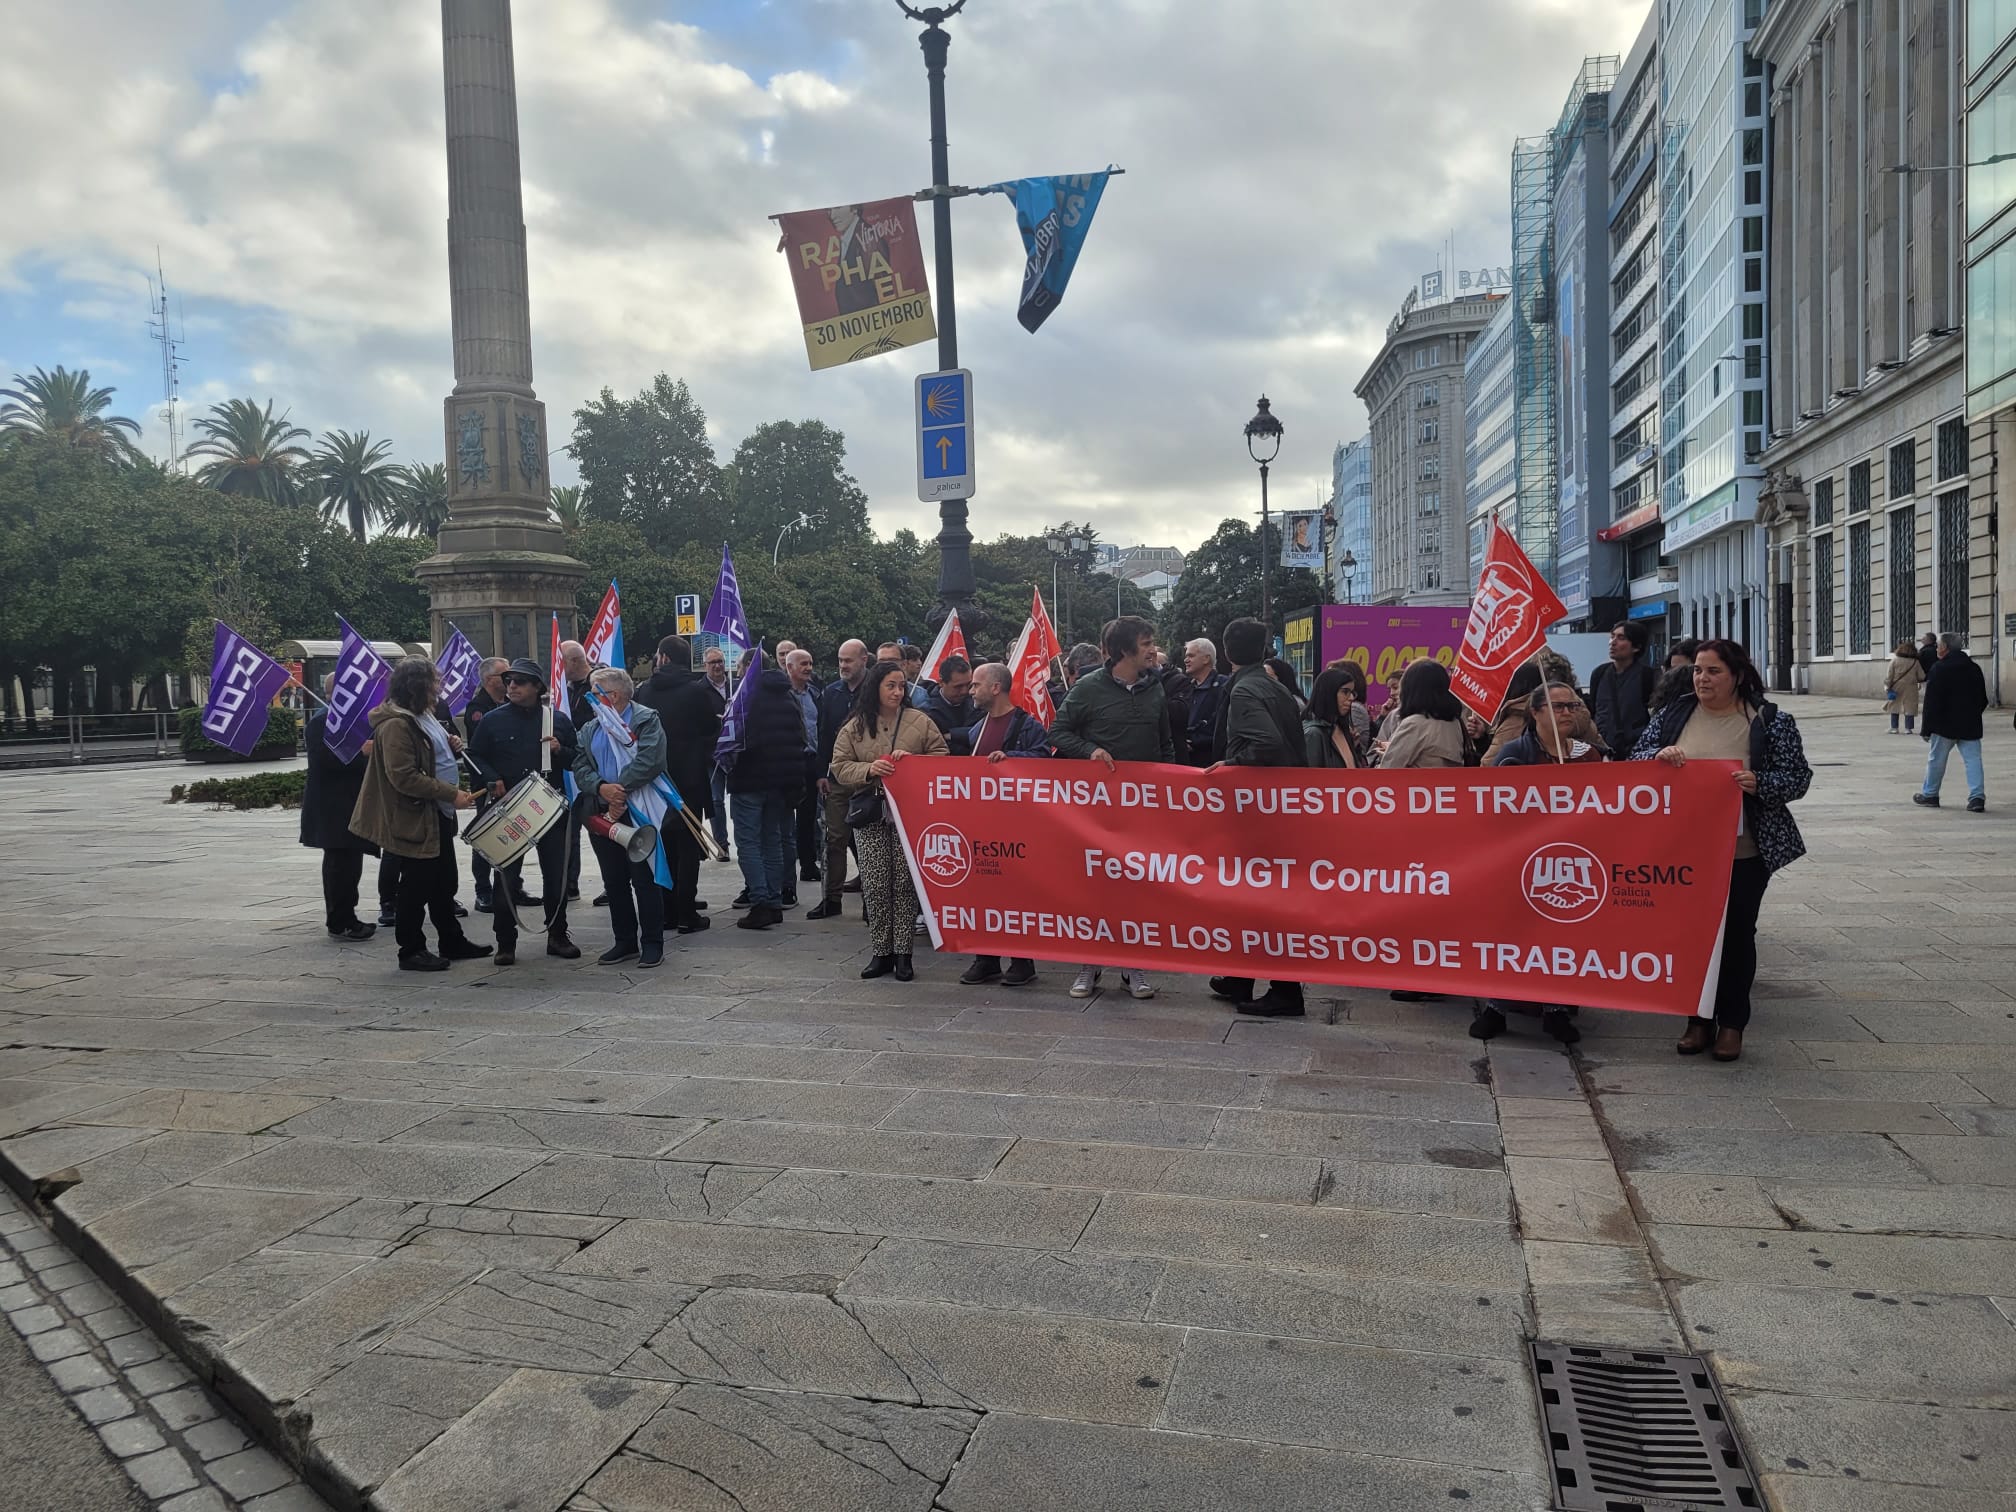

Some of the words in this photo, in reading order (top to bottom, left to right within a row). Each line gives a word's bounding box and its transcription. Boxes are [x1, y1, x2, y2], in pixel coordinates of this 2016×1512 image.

[820, 251, 894, 292] PHA
[875, 271, 916, 305] EL
[814, 324, 837, 346] 30
[839, 299, 924, 340] NOVEMBRO
[681, 597, 691, 614] P
[928, 776, 971, 805] ¡EN
[980, 777, 1112, 806] DEFENSA
[1120, 781, 1160, 808] DE
[1166, 786, 1225, 813] LOS
[1234, 786, 1396, 815] PUESTOS
[1408, 786, 1457, 814] DE
[1468, 784, 1671, 815] TRABAJO!
[924, 833, 961, 858] UGT
[972, 840, 1026, 859] FeSMC
[1084, 848, 1205, 885] FeSMC
[1218, 856, 1297, 889] UGT
[1309, 860, 1450, 896] Coruña
[1533, 857, 1592, 887] UGT
[1611, 863, 1694, 886] FeSMC
[1611, 886, 1650, 897] Galicia
[1621, 899, 1655, 908] CORUÑA
[985, 908, 1115, 942] DEFENSA
[1121, 920, 1162, 947] DE
[1170, 924, 1232, 952] LOS
[1241, 930, 1401, 964] PUESTOS
[1412, 939, 1461, 969] DE
[1472, 942, 1673, 984] TRABAJO!
